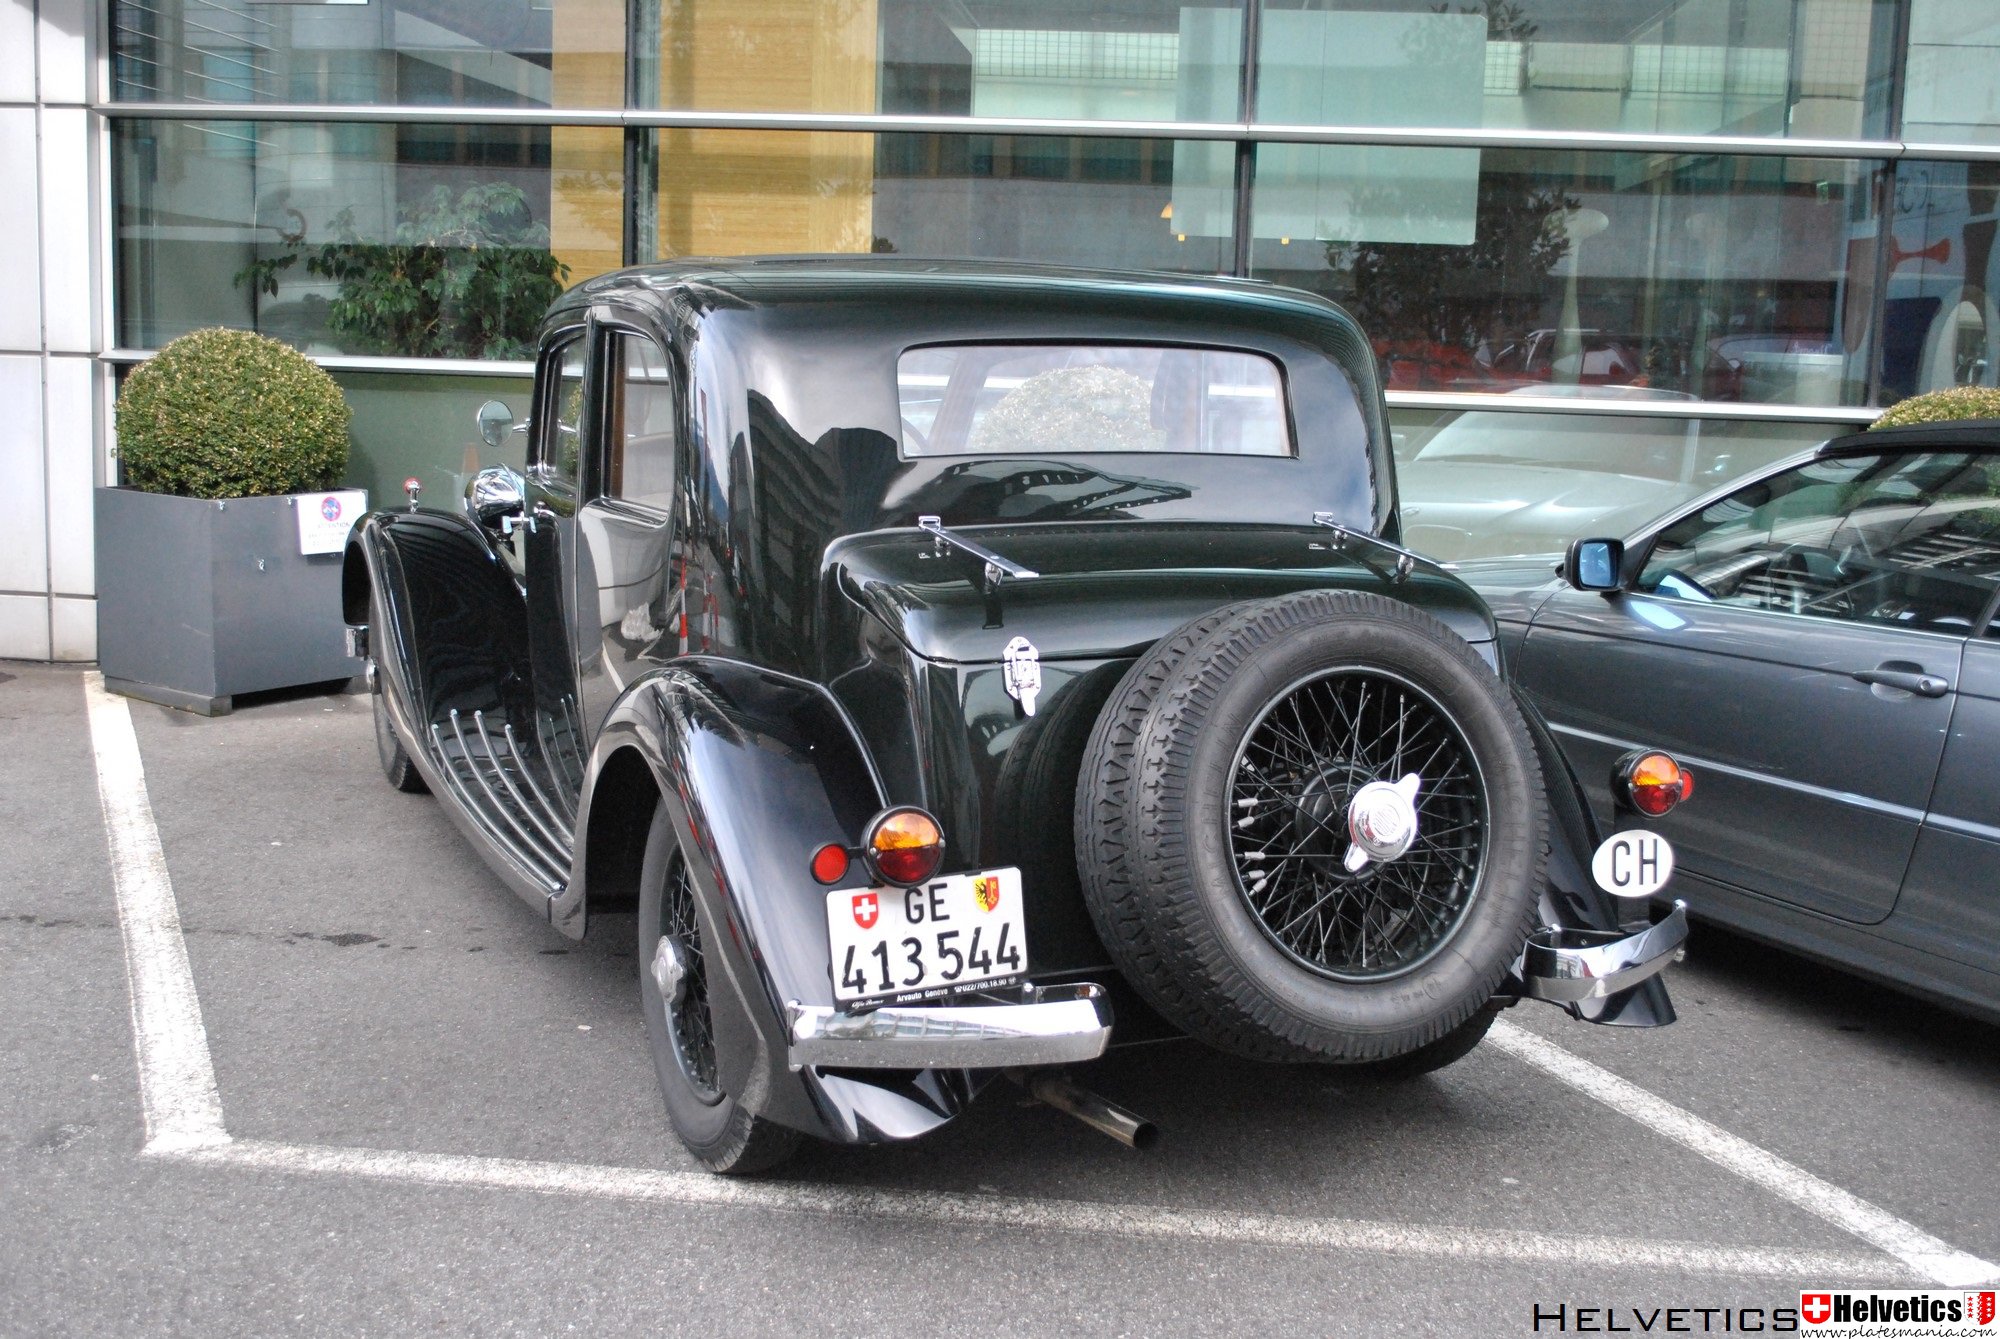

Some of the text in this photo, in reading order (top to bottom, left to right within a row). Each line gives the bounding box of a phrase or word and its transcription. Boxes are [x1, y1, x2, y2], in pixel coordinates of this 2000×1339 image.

[1611, 838, 1658, 887] CH
[904, 882, 950, 925] GE
[842, 922, 1021, 994] 413 544
[896, 992, 922, 1002] Arvauto
